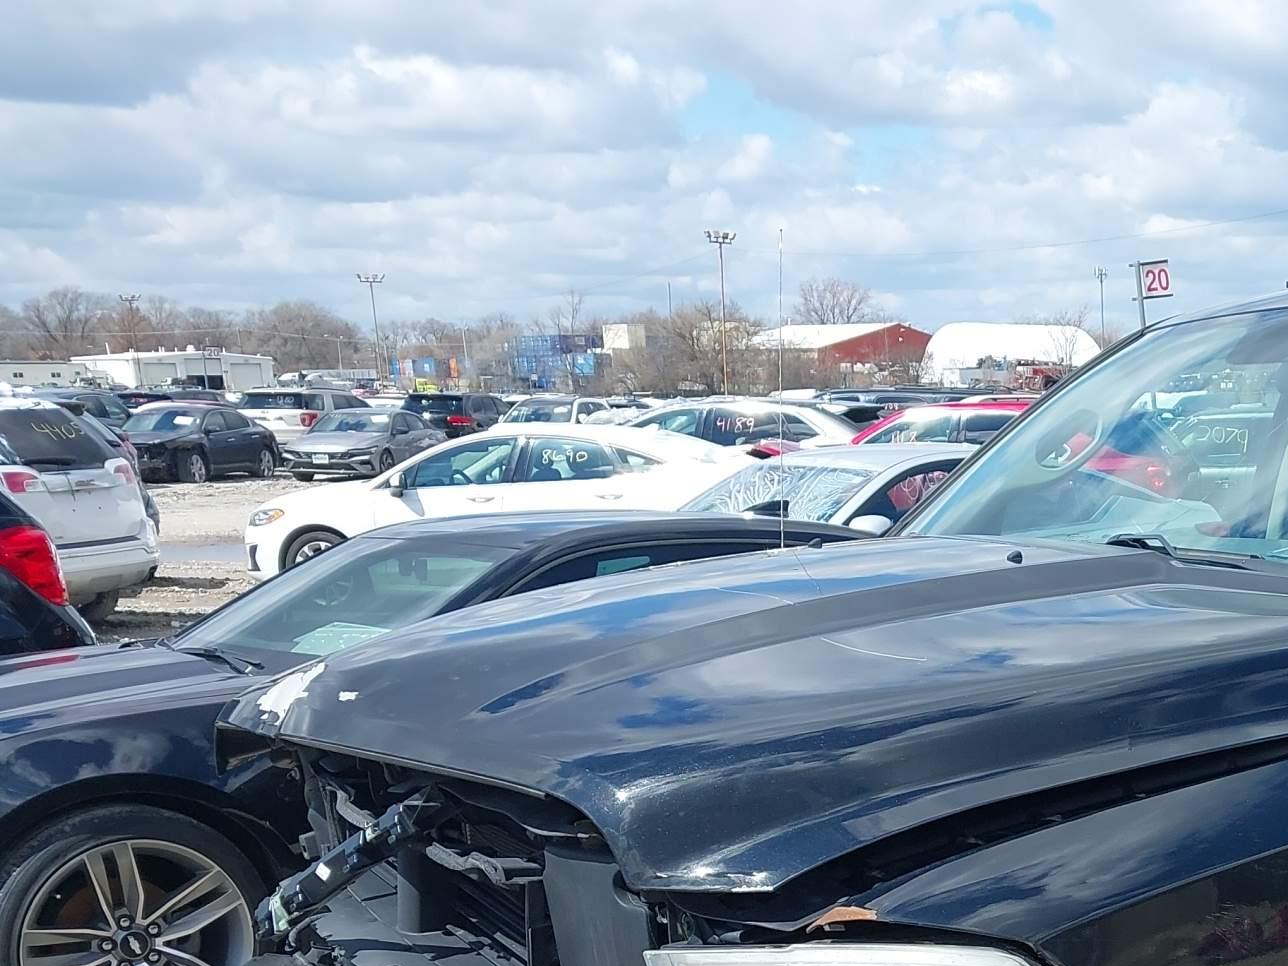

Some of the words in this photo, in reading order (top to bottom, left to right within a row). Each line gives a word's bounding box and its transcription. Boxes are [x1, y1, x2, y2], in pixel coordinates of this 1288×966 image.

[1145, 268, 1169, 292] 20
[716, 416, 755, 433] 4189
[541, 448, 588, 464] 8690
